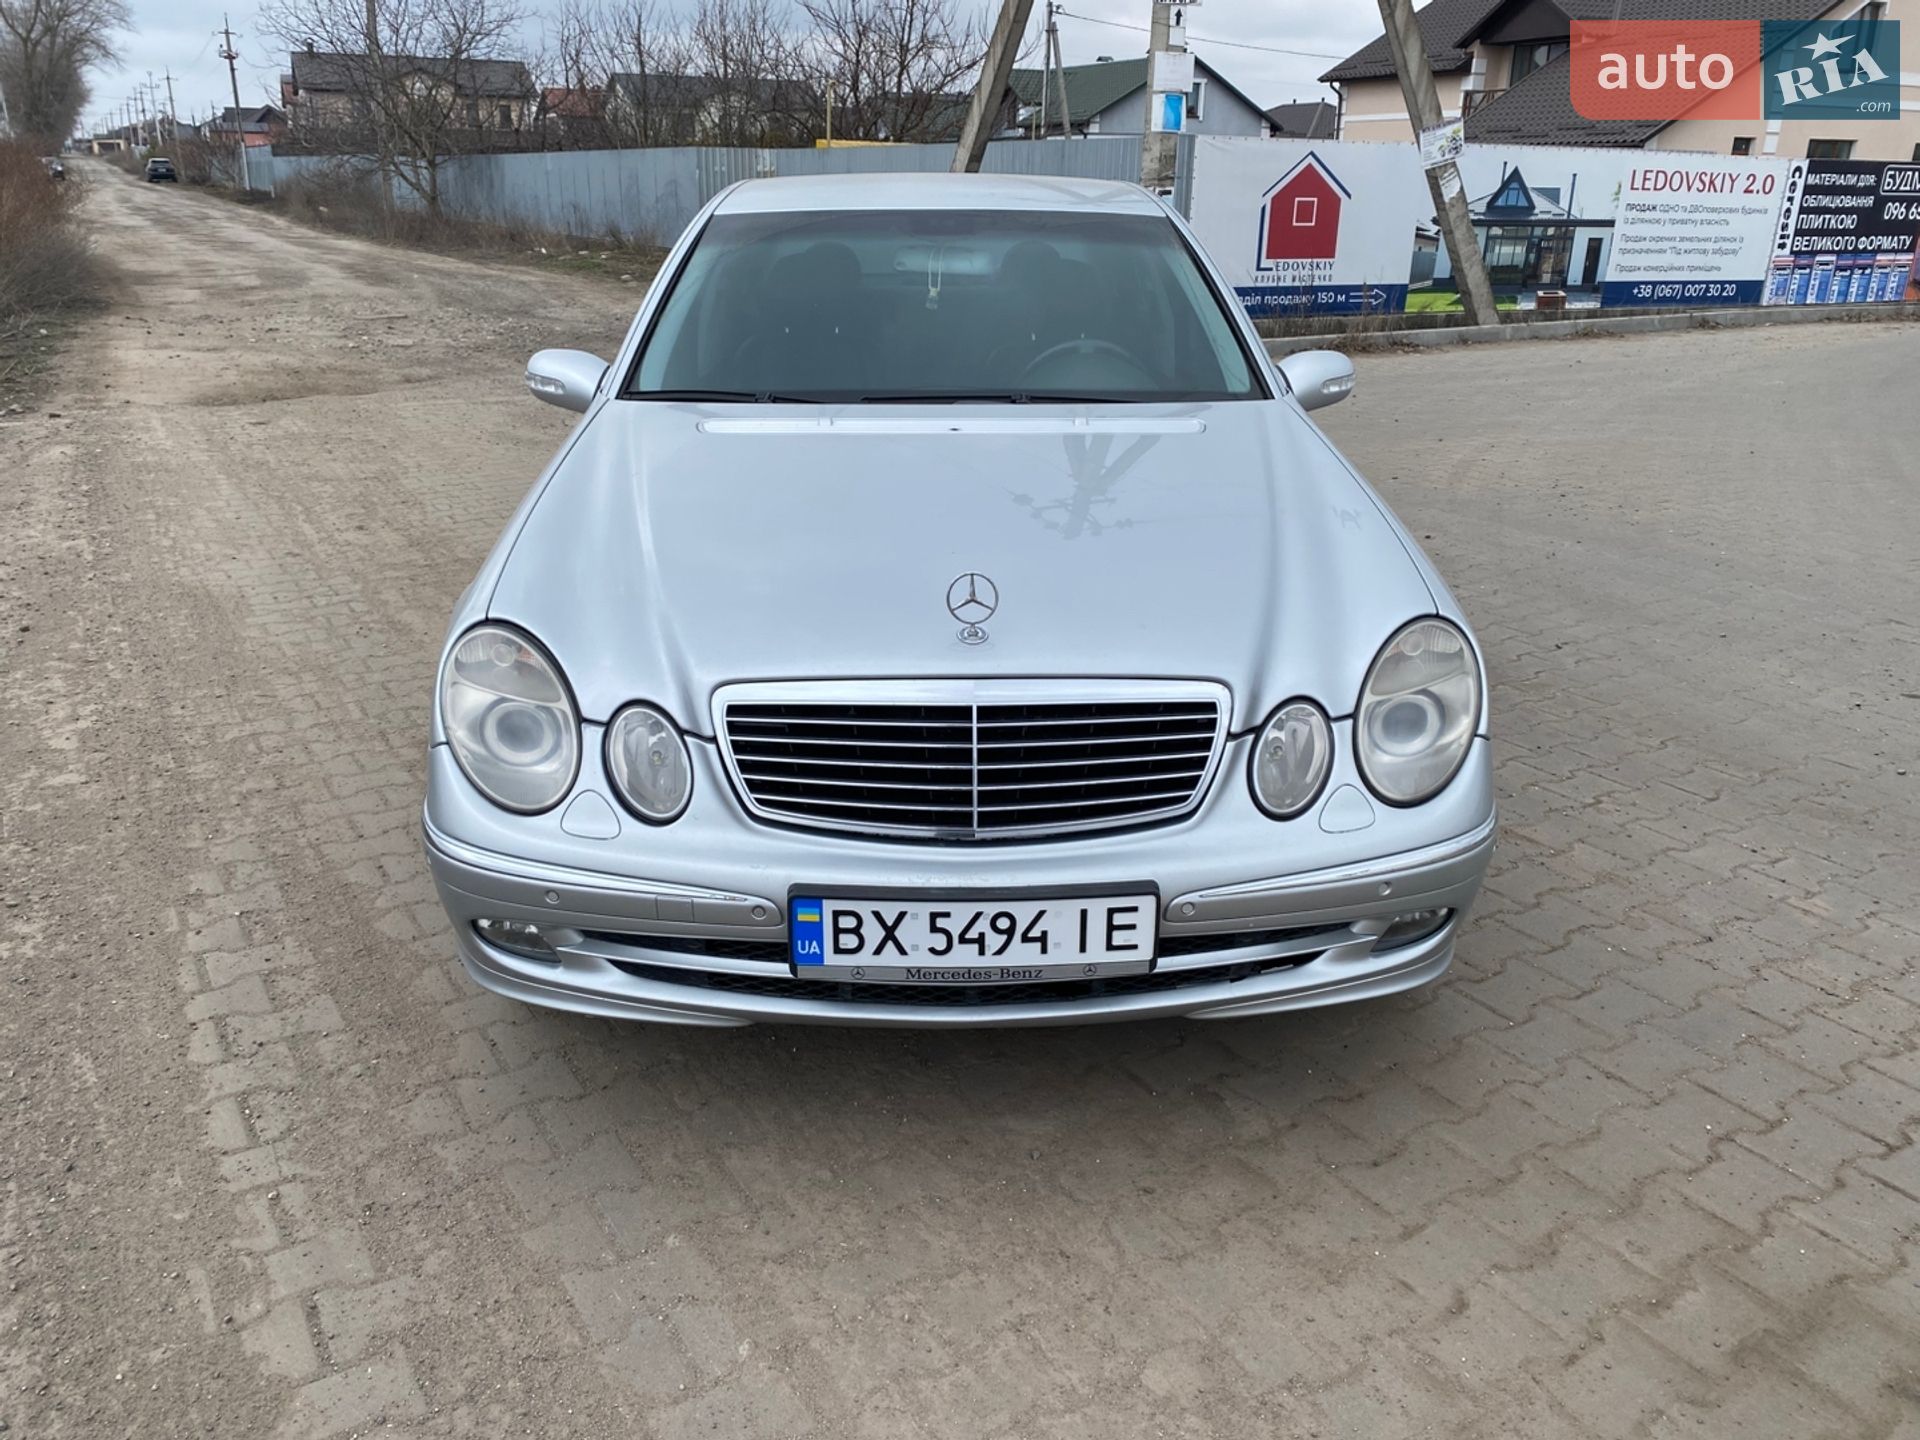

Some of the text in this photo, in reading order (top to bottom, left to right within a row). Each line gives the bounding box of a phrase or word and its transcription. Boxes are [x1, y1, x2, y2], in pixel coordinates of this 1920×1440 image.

[1630, 169, 1775, 195] LEDOVSKIY 2.0
[1806, 173, 1857, 186] МАТЕРІАЛИ
[1625, 203, 1657, 212] ПРОДАЖ
[1777, 165, 1803, 251] Ceresit
[1802, 195, 1875, 208] ОБЛИЦЮВАННЯ
[1884, 202, 1906, 220] 096
[1797, 215, 1857, 229] ПЛИТКОЮ
[1793, 235, 1912, 250] ВЕЛИКОГО ФОРМАТУ
[1317, 292, 1335, 303] 150
[1632, 283, 1736, 299] +38 (067) 007 30 20
[831, 906, 1139, 957] BX 5494 IE
[797, 940, 821, 955] UA
[905, 966, 1044, 981] Mercedes-Benz
